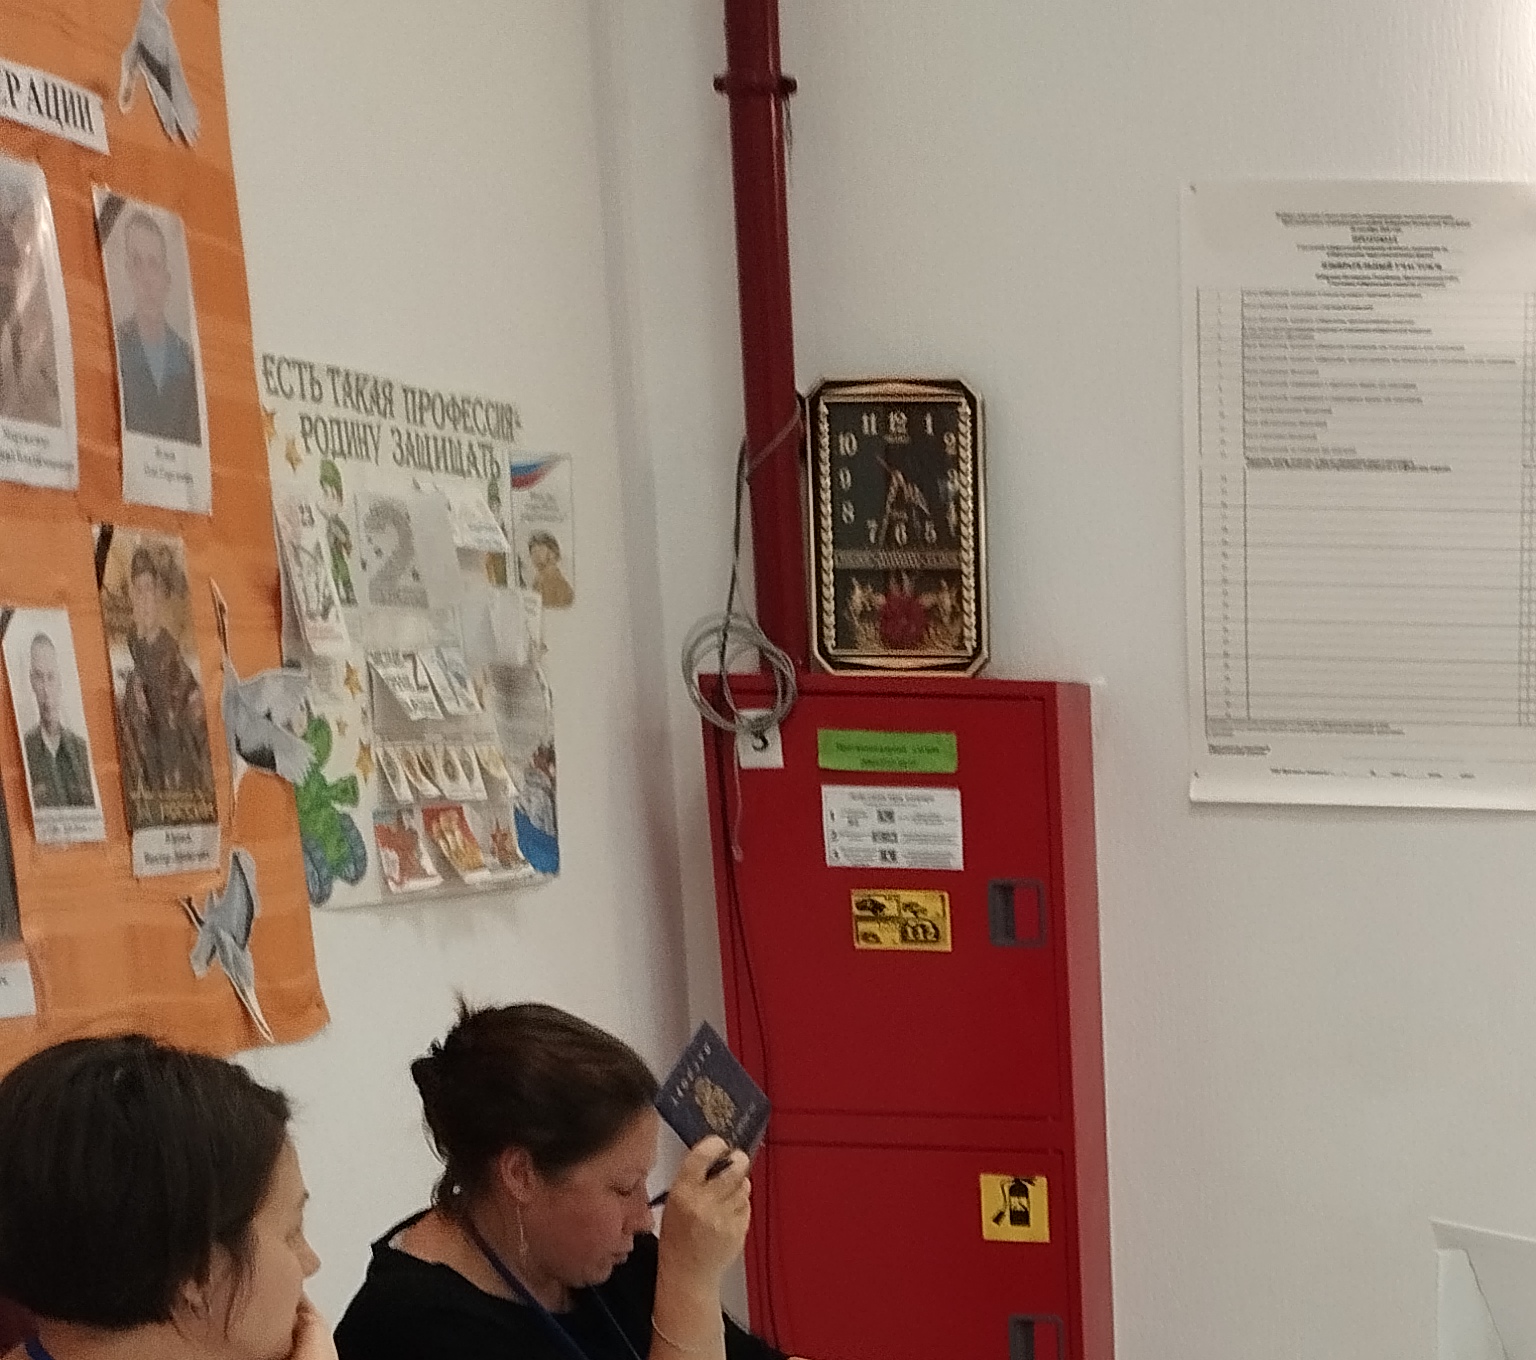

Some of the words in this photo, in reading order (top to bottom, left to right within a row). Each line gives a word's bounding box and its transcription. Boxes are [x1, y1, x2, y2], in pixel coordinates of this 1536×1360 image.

[0, 68, 95, 134] РАЦИИ
[261, 352, 323, 404] ЕСТЬ
[326, 364, 395, 420] ТАКАЯ
[300, 413, 381, 466] РОДИНУ
[391, 427, 501, 480] ЗАЩИЩАТЬ
[838, 431, 858, 456] 10
[842, 501, 855, 525] 8
